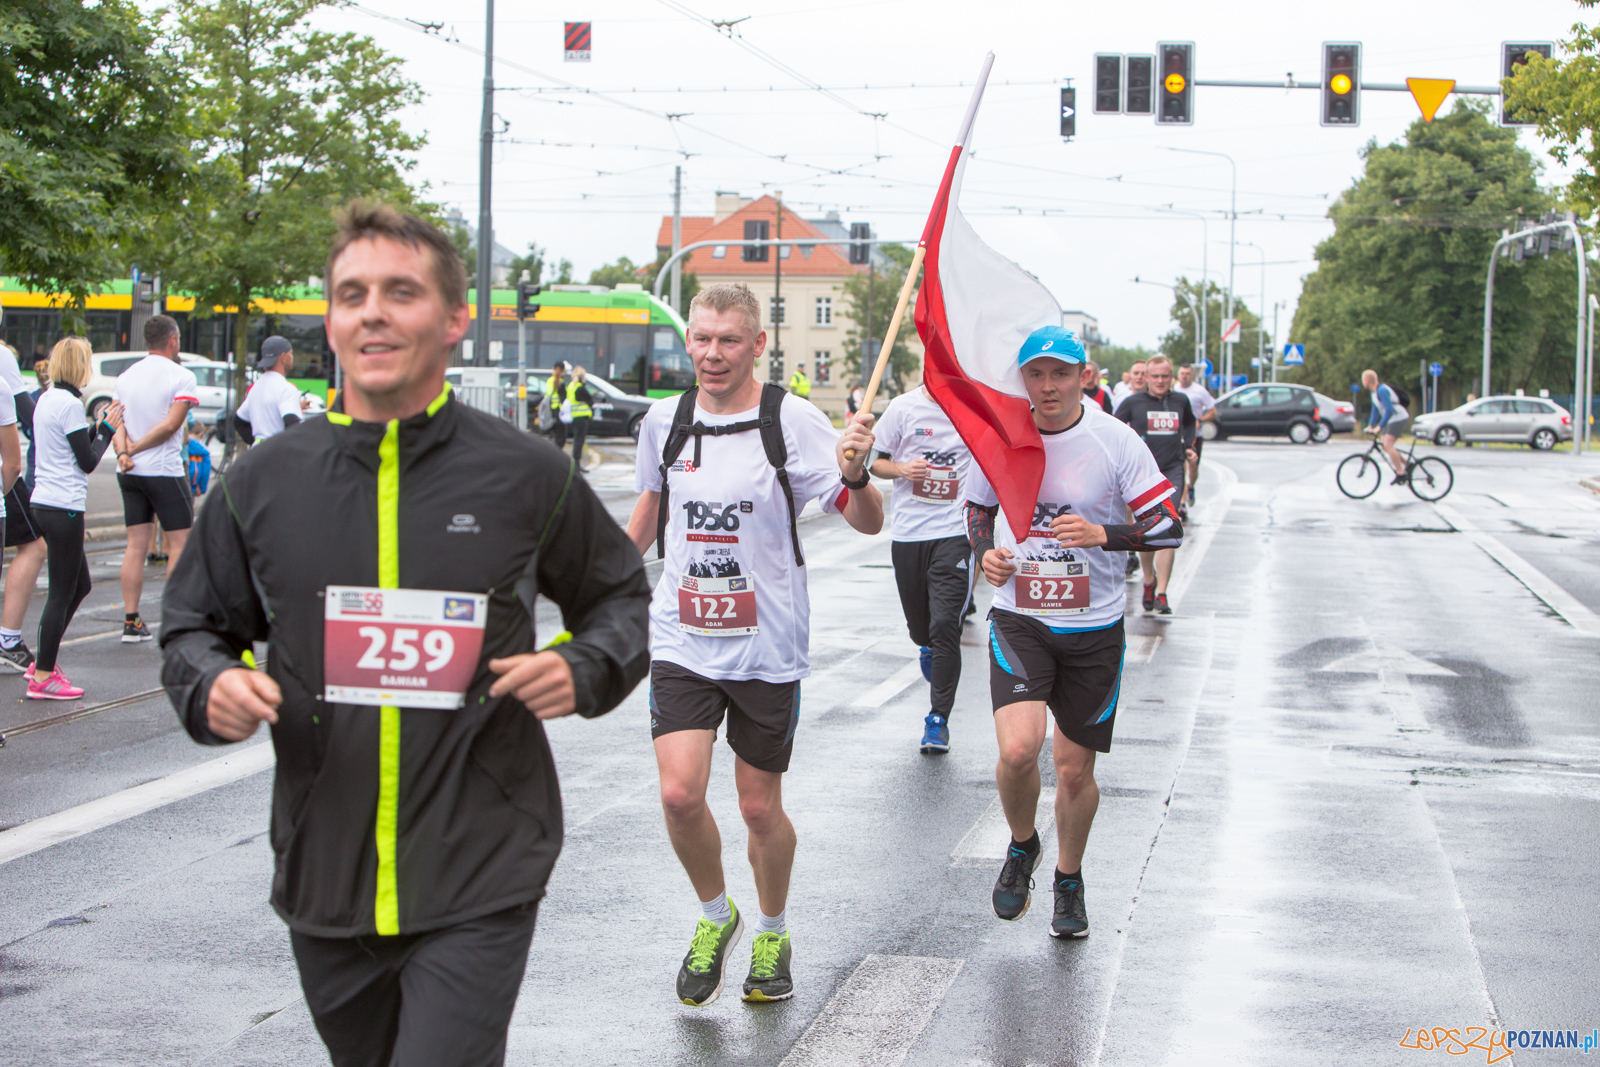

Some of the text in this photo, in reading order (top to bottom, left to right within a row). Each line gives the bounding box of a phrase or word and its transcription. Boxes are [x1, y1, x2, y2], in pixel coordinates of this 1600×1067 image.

[1153, 419, 1174, 428] 800
[922, 480, 951, 494] 525
[682, 500, 740, 532] 1956
[1029, 580, 1075, 600] 822
[691, 596, 737, 619] 122
[356, 626, 455, 672] 259
[380, 675, 428, 687] DAMIAN
